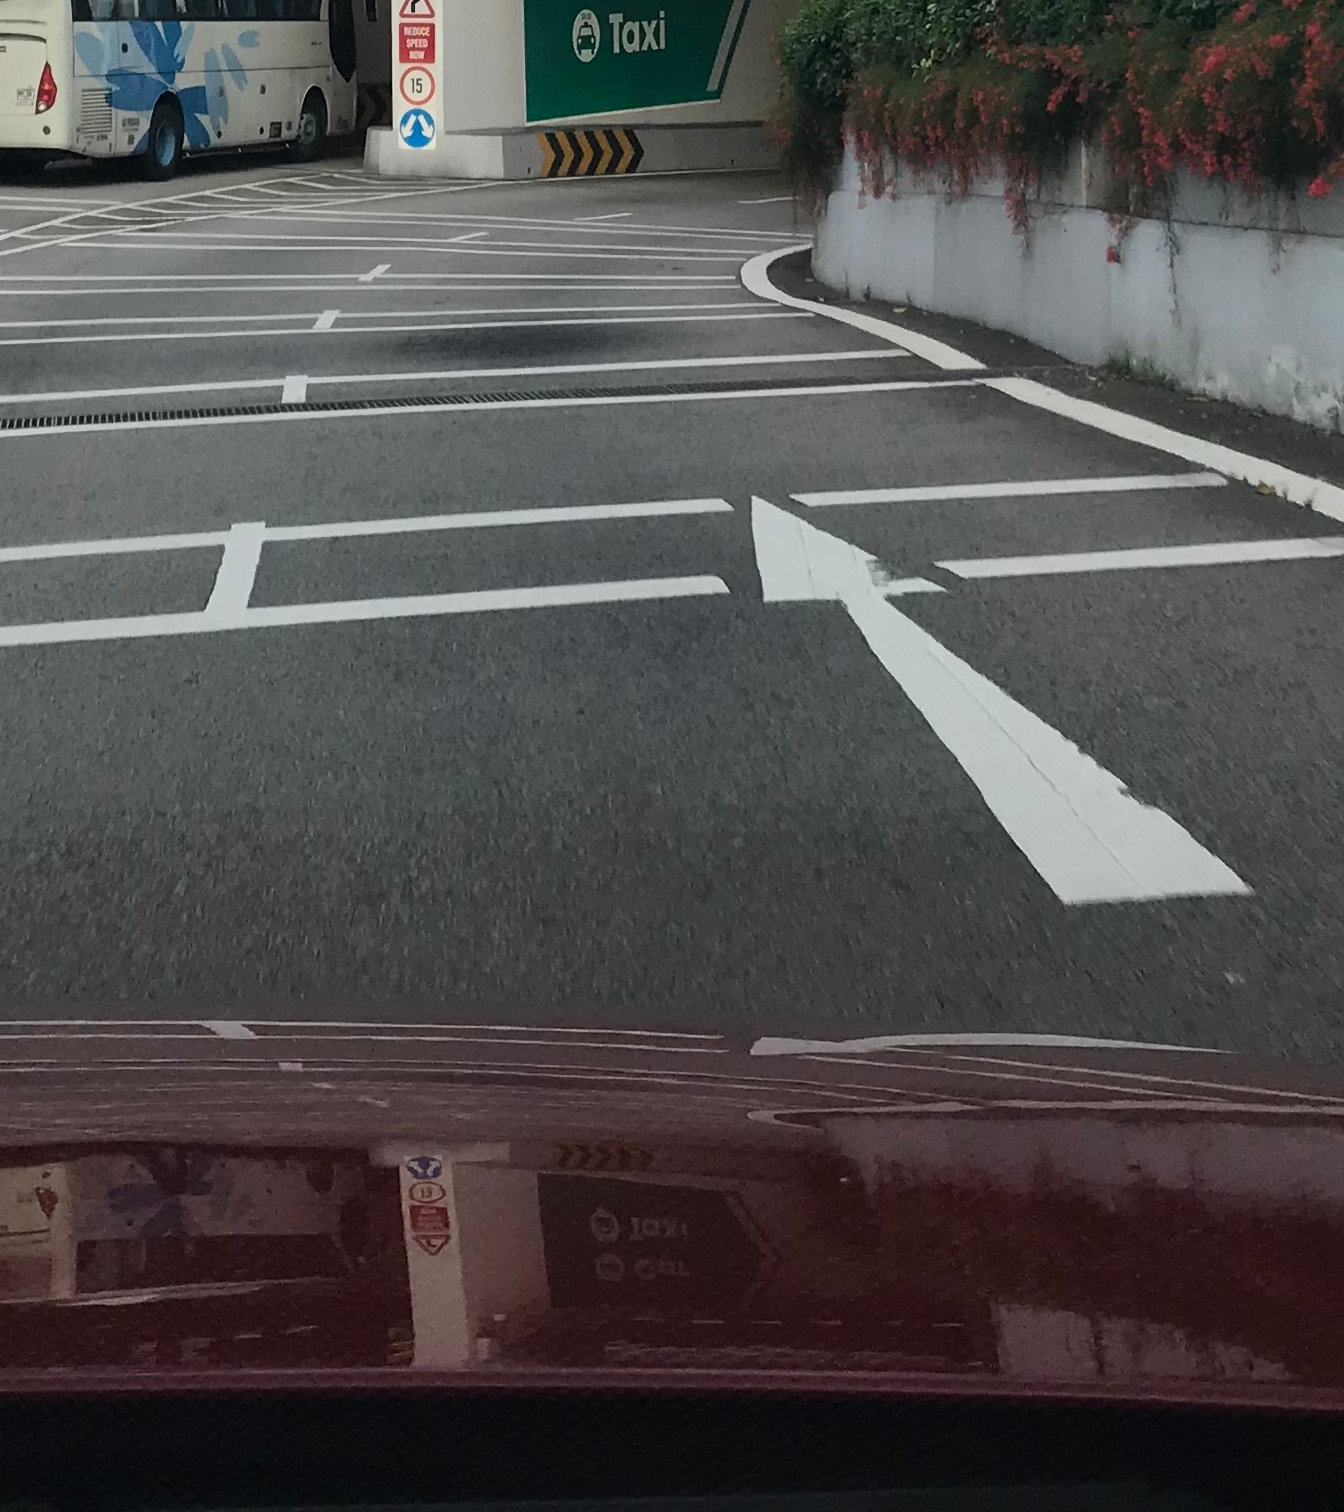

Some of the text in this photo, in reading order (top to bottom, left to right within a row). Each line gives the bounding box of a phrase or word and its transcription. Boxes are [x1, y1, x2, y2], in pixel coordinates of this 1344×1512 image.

[404, 27, 431, 37] REDUCE
[608, 10, 666, 54] Taxi
[406, 38, 428, 48] SPEED
[408, 50, 426, 59] NOW
[411, 78, 423, 94] 15
